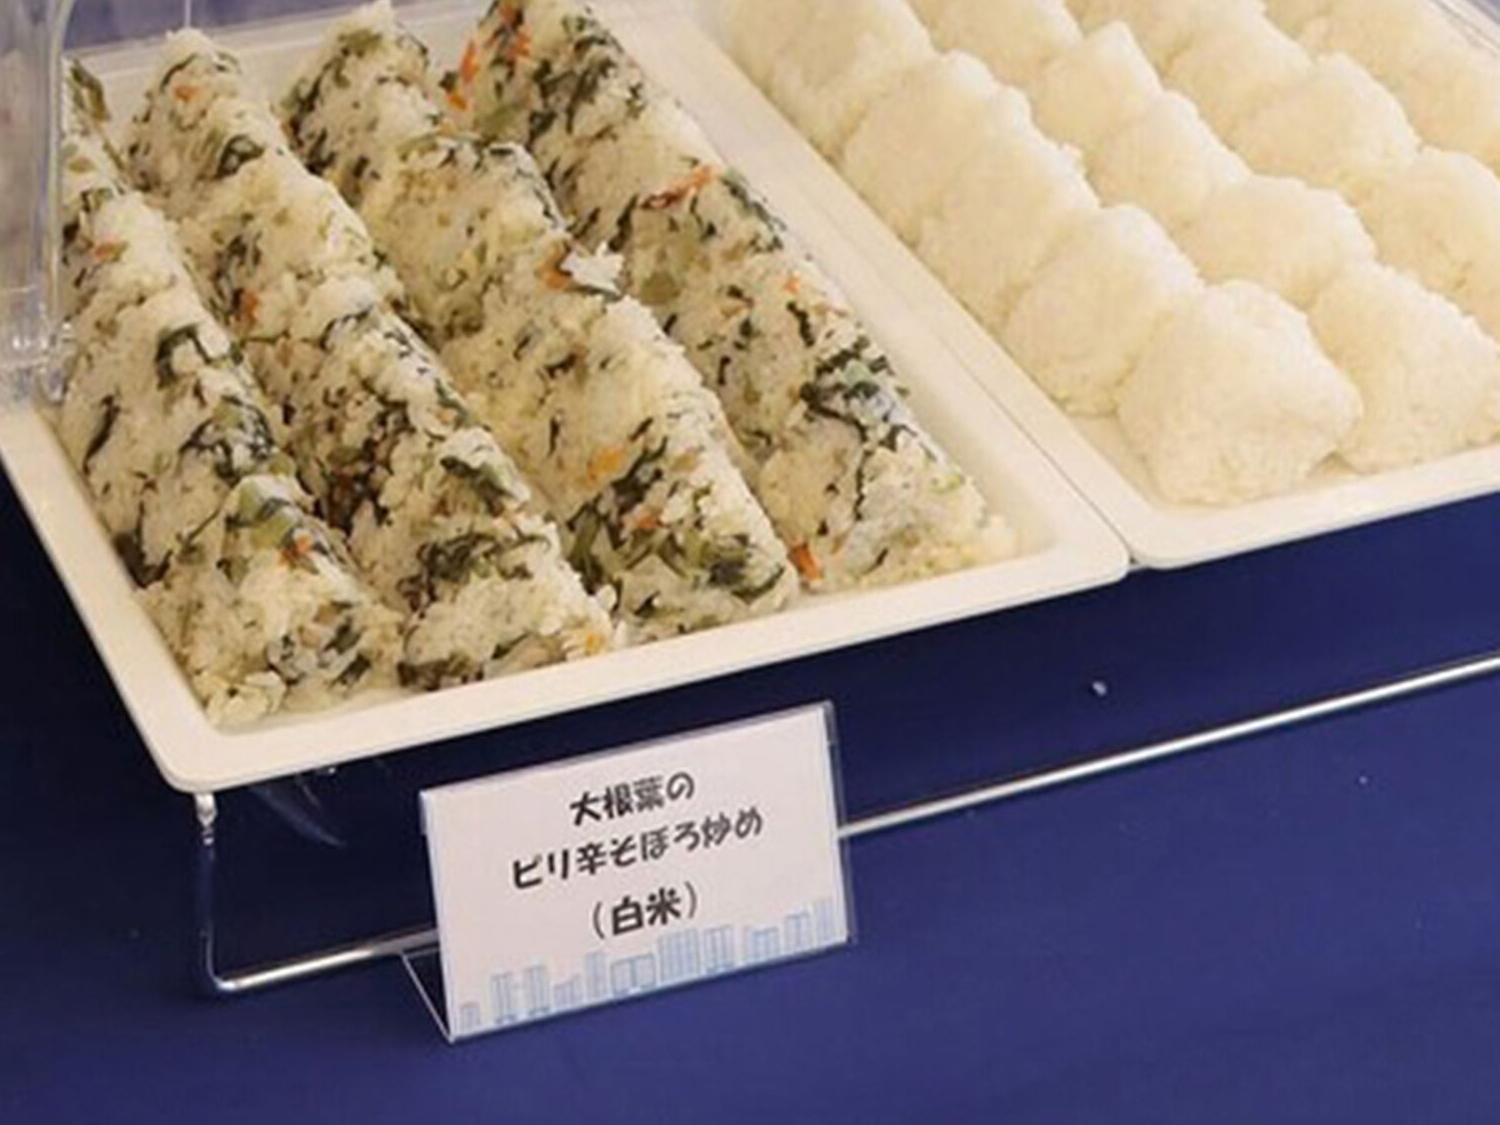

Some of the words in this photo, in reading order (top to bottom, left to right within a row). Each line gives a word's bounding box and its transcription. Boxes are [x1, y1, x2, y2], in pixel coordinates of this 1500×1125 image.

[569, 771, 695, 827] 大根葉の
[592, 881, 698, 940] （白米）
